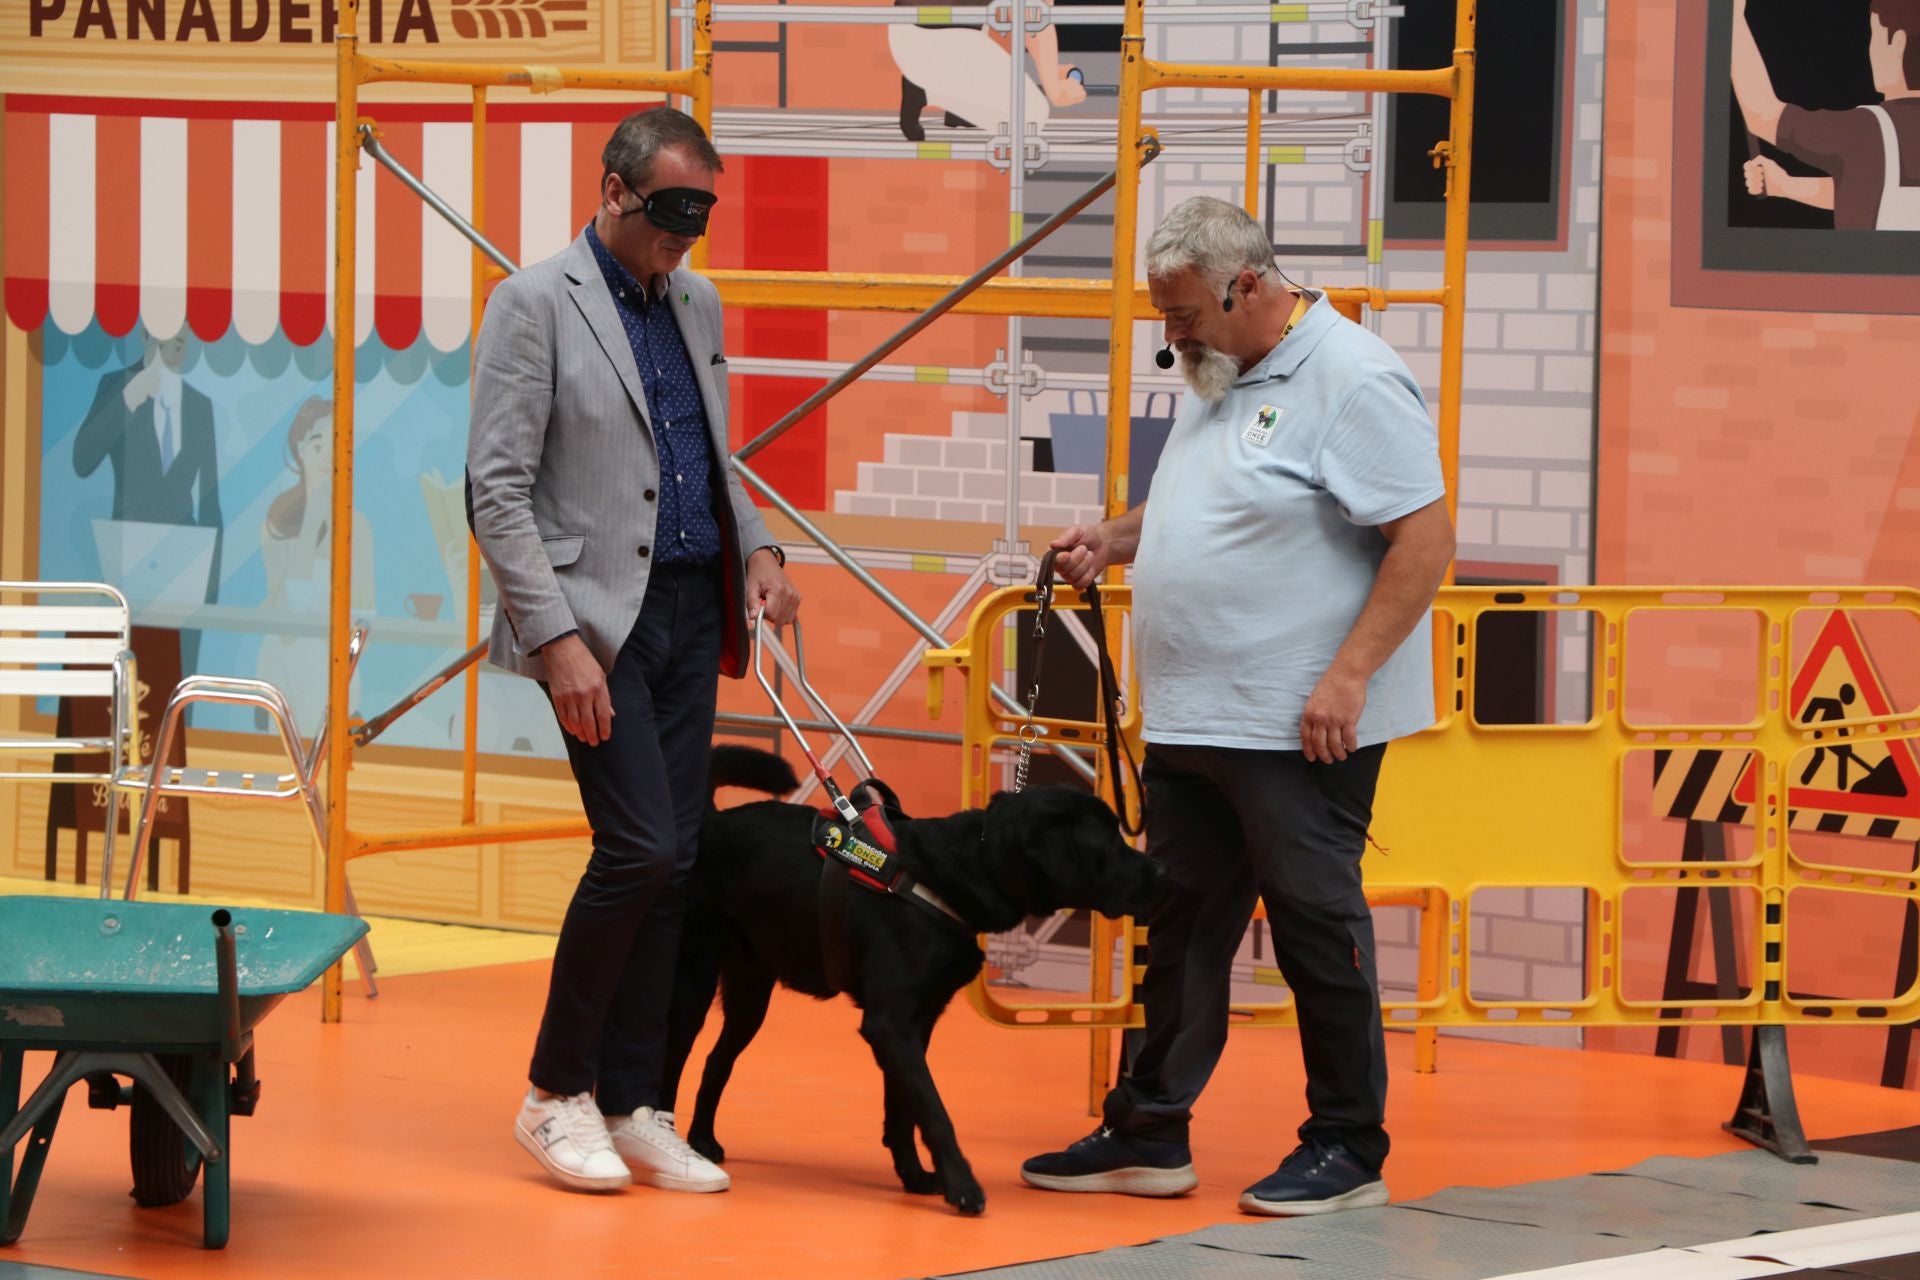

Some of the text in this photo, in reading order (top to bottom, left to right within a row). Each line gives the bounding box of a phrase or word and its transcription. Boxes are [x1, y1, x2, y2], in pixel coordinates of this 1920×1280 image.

[1247, 431, 1267, 441] ONCE
[850, 836, 888, 859] FUNDACIÓN
[842, 849, 863, 863] PERRO
[856, 847, 882, 865] ONCE
